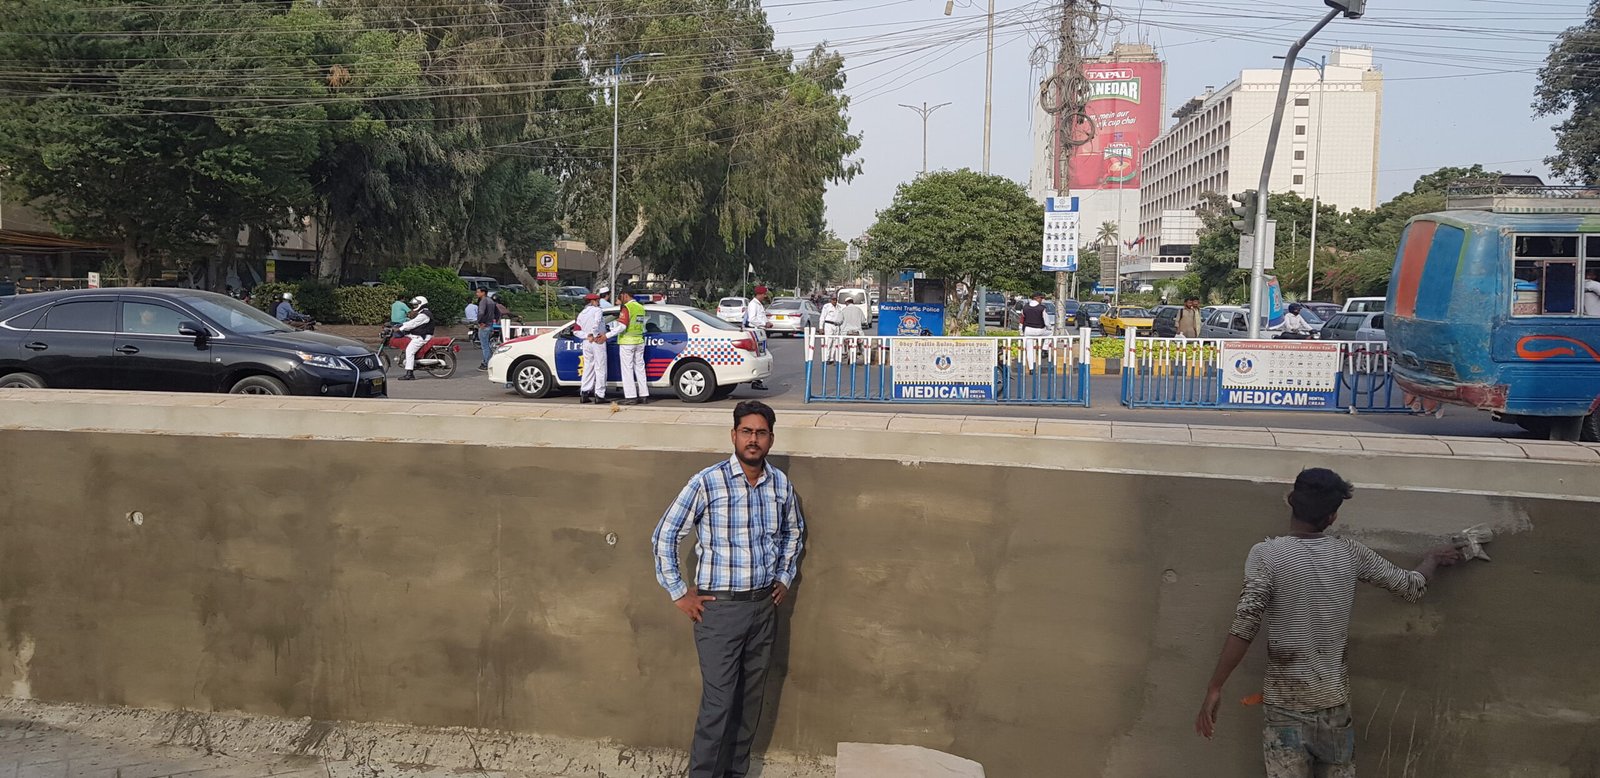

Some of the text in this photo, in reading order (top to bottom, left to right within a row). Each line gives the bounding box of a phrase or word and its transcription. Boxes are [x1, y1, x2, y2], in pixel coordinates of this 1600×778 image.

[1087, 71, 1130, 79] TAPAL
[1107, 119, 1121, 127] cup
[1121, 117, 1137, 125] chai
[544, 256, 552, 267] P
[691, 324, 700, 334] 6
[902, 386, 969, 399] MEDICAM
[1229, 390, 1308, 406] MEDICAM
